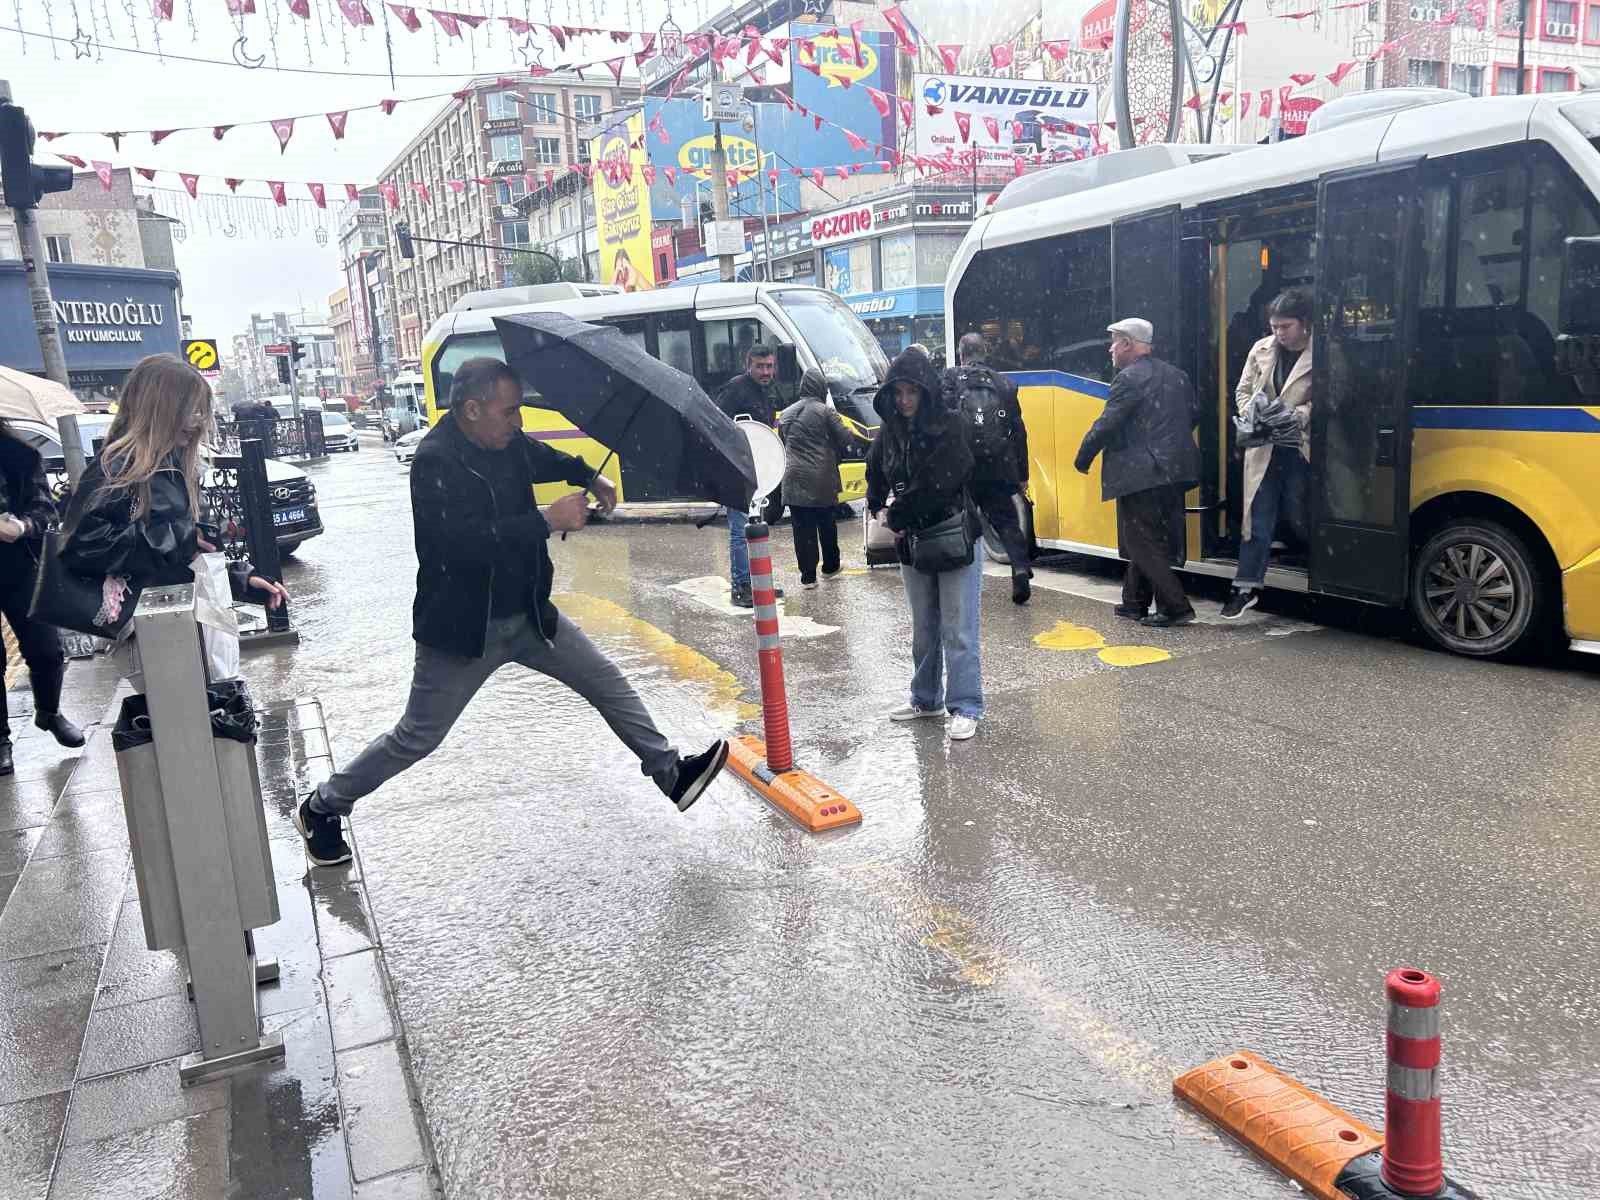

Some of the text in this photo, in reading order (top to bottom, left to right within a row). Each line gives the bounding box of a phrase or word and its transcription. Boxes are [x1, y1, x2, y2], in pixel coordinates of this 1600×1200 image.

[949, 84, 1090, 108] VANGÖLÜ
[688, 142, 758, 169] grtis
[811, 208, 871, 240] eczane
[52, 297, 163, 325] NTEROĞLU
[68, 329, 143, 342] KUYUMCULUK
